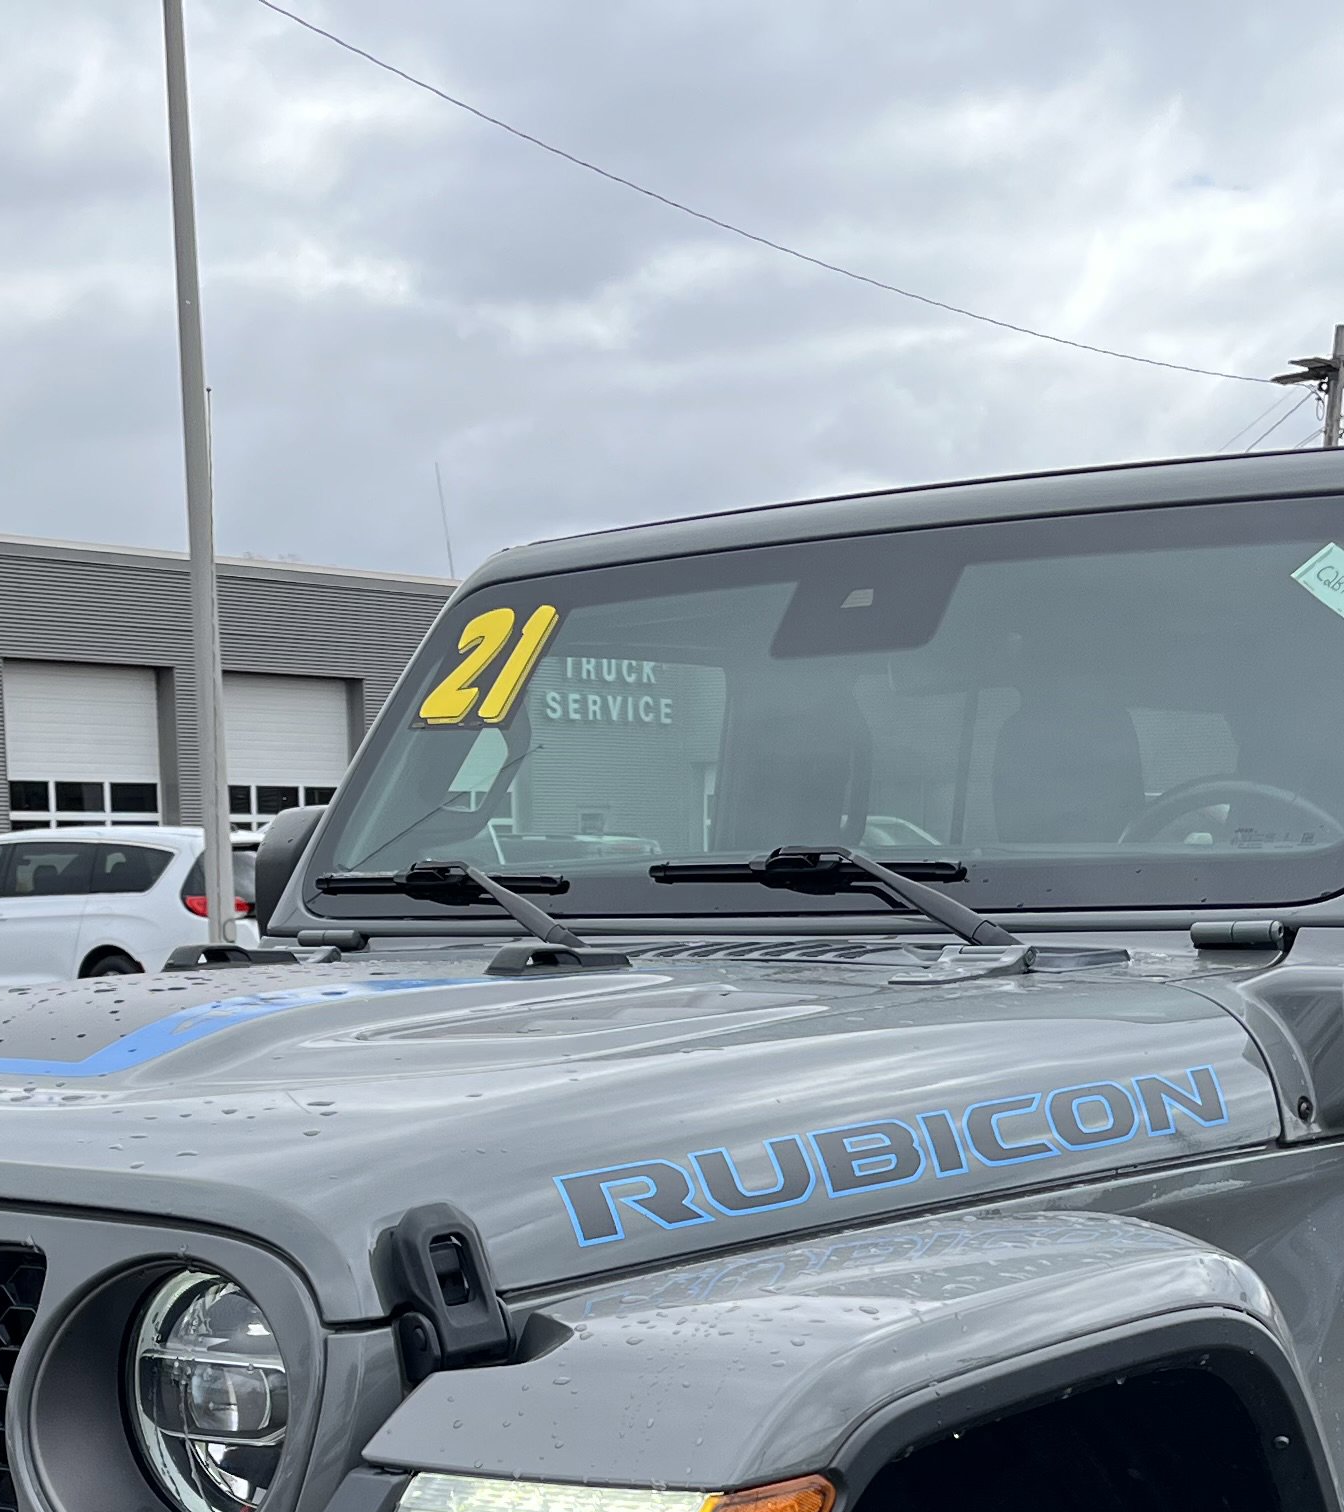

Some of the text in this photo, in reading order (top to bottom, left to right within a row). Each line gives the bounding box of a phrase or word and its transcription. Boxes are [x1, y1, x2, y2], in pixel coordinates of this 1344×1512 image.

[419, 604, 559, 725] 21
[566, 656, 657, 684] TRUCK
[545, 691, 673, 724] SERVICE
[553, 1064, 1229, 1248] RUBICON
